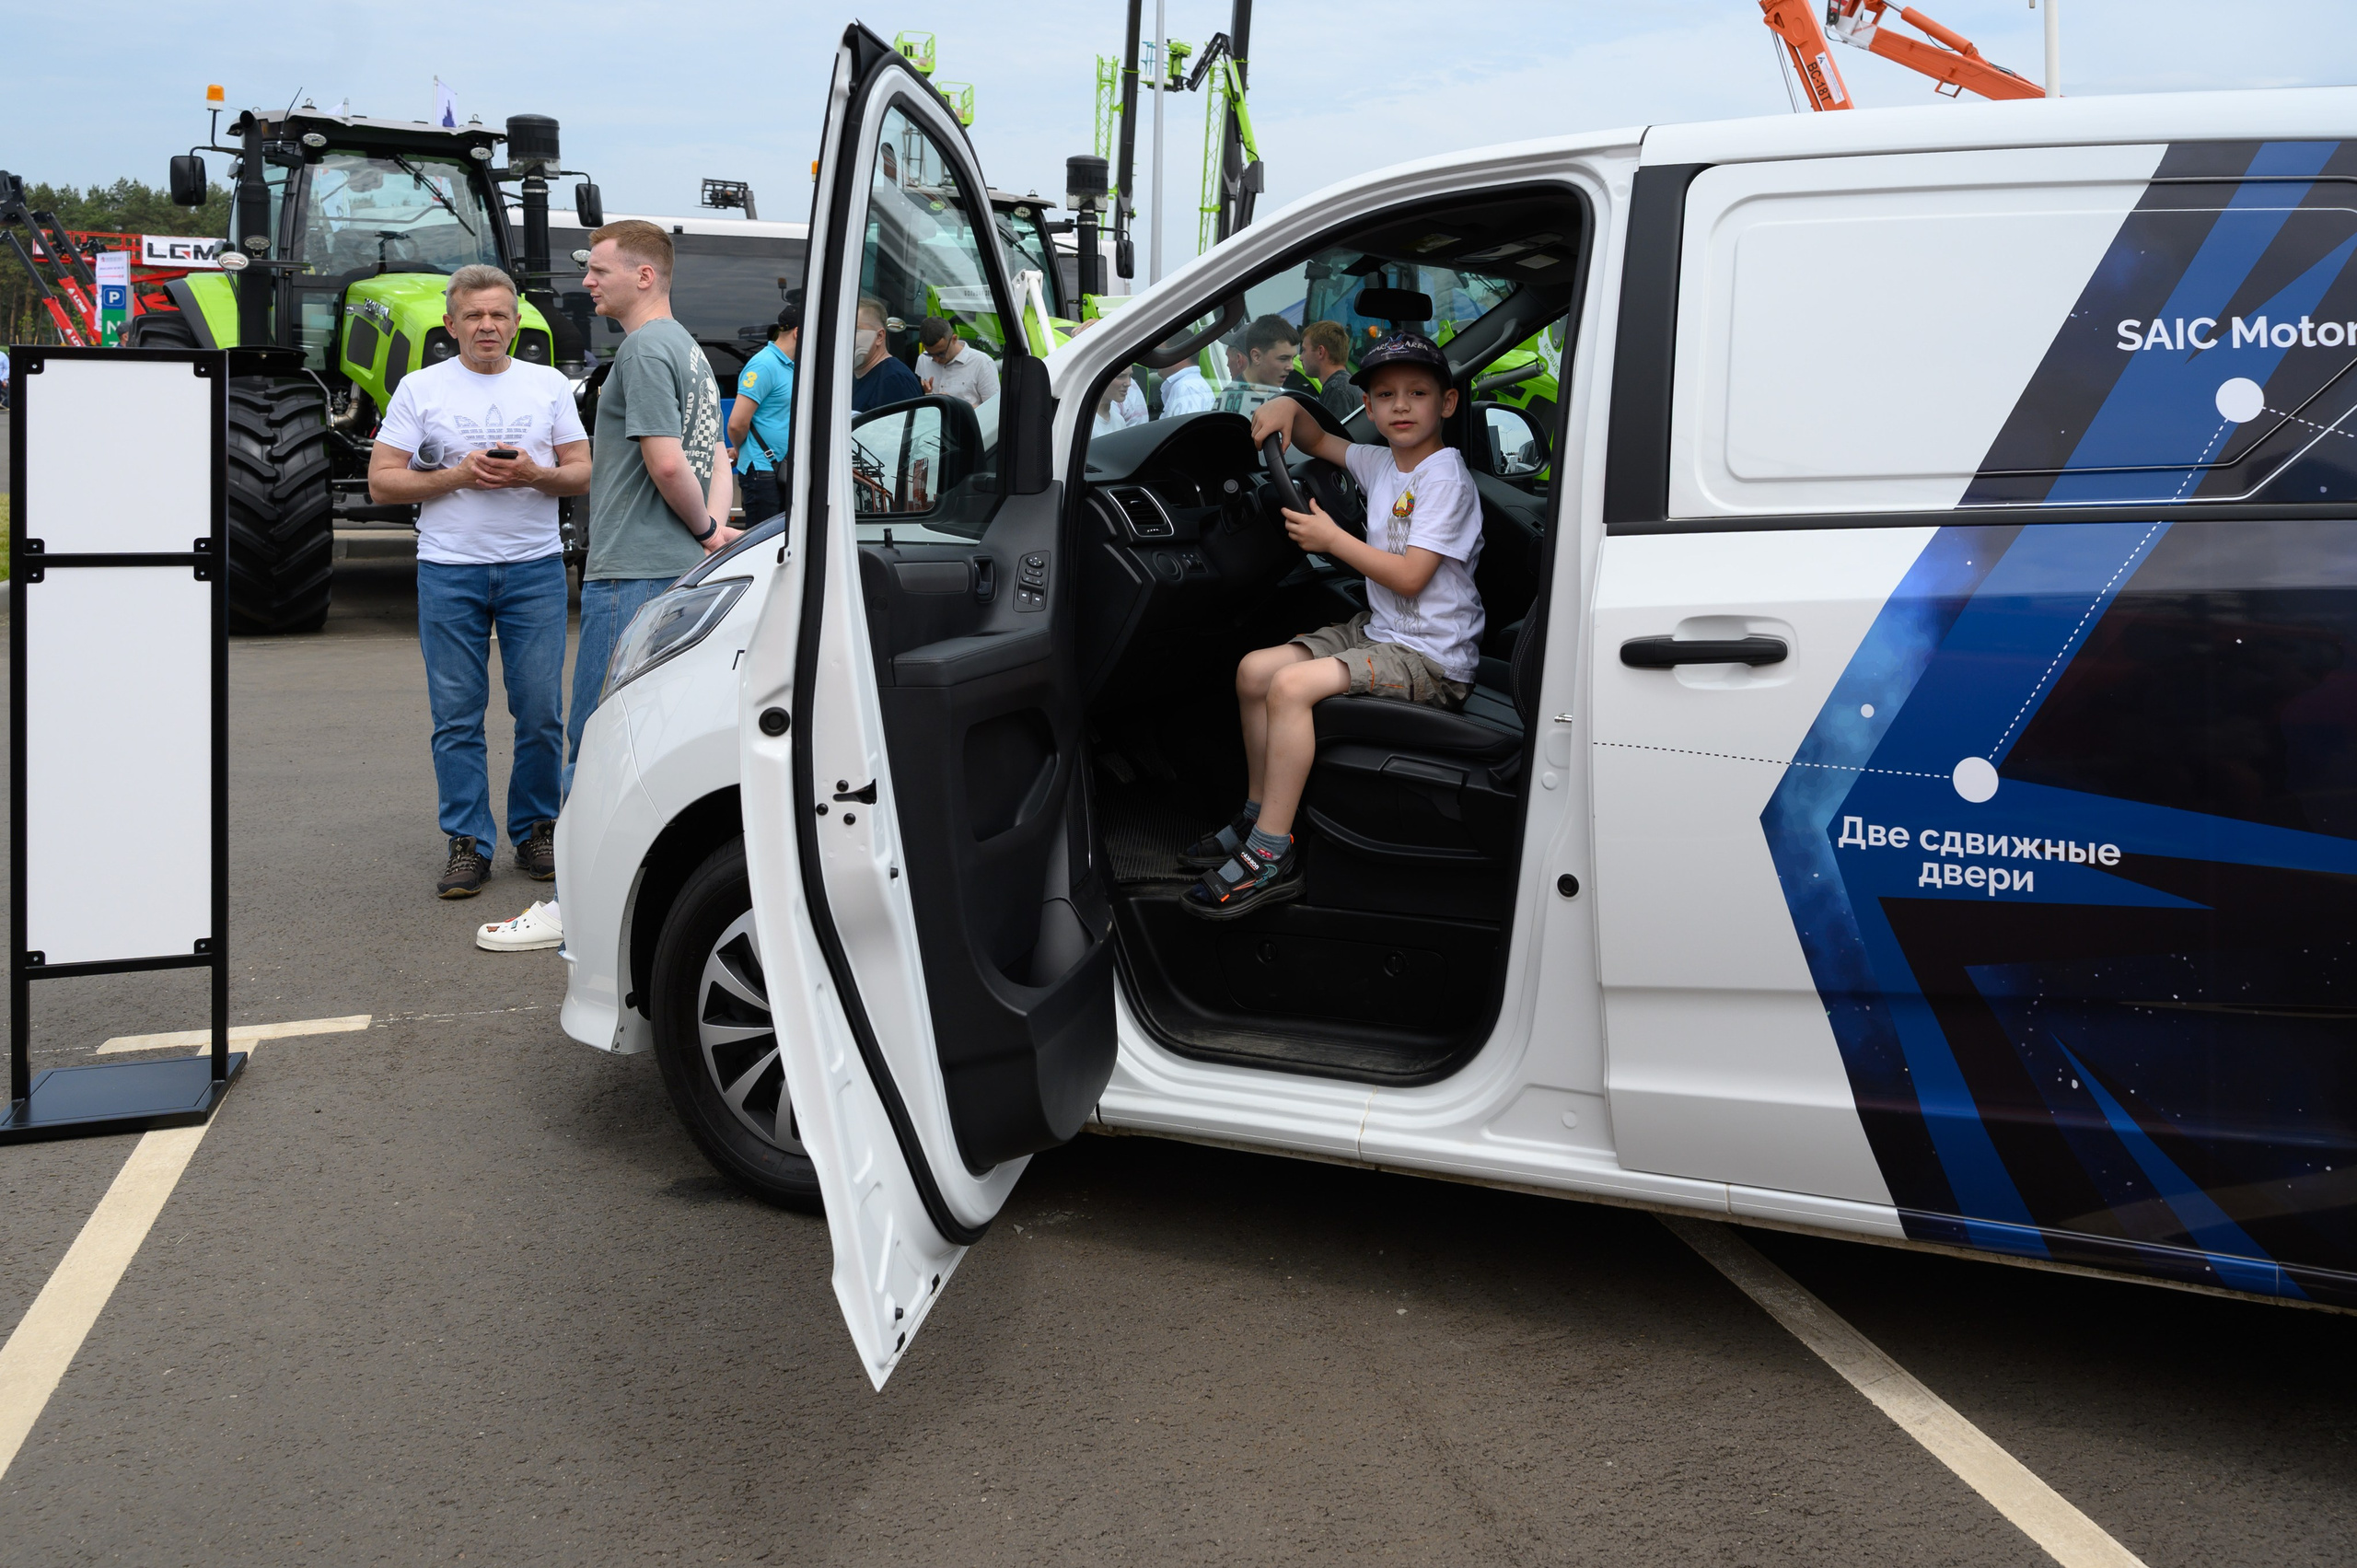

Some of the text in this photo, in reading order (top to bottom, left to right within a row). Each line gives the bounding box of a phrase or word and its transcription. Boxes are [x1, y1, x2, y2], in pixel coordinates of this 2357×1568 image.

[147, 243, 215, 261] LGM
[109, 291, 121, 304] P
[1405, 340, 1428, 351] AREA
[2117, 315, 2357, 352] SAIC Motor
[1543, 343, 1560, 377] ROBUS
[742, 371, 758, 389] 3
[1838, 815, 2121, 865] Две сдвижные
[1918, 862, 2034, 897] двери
